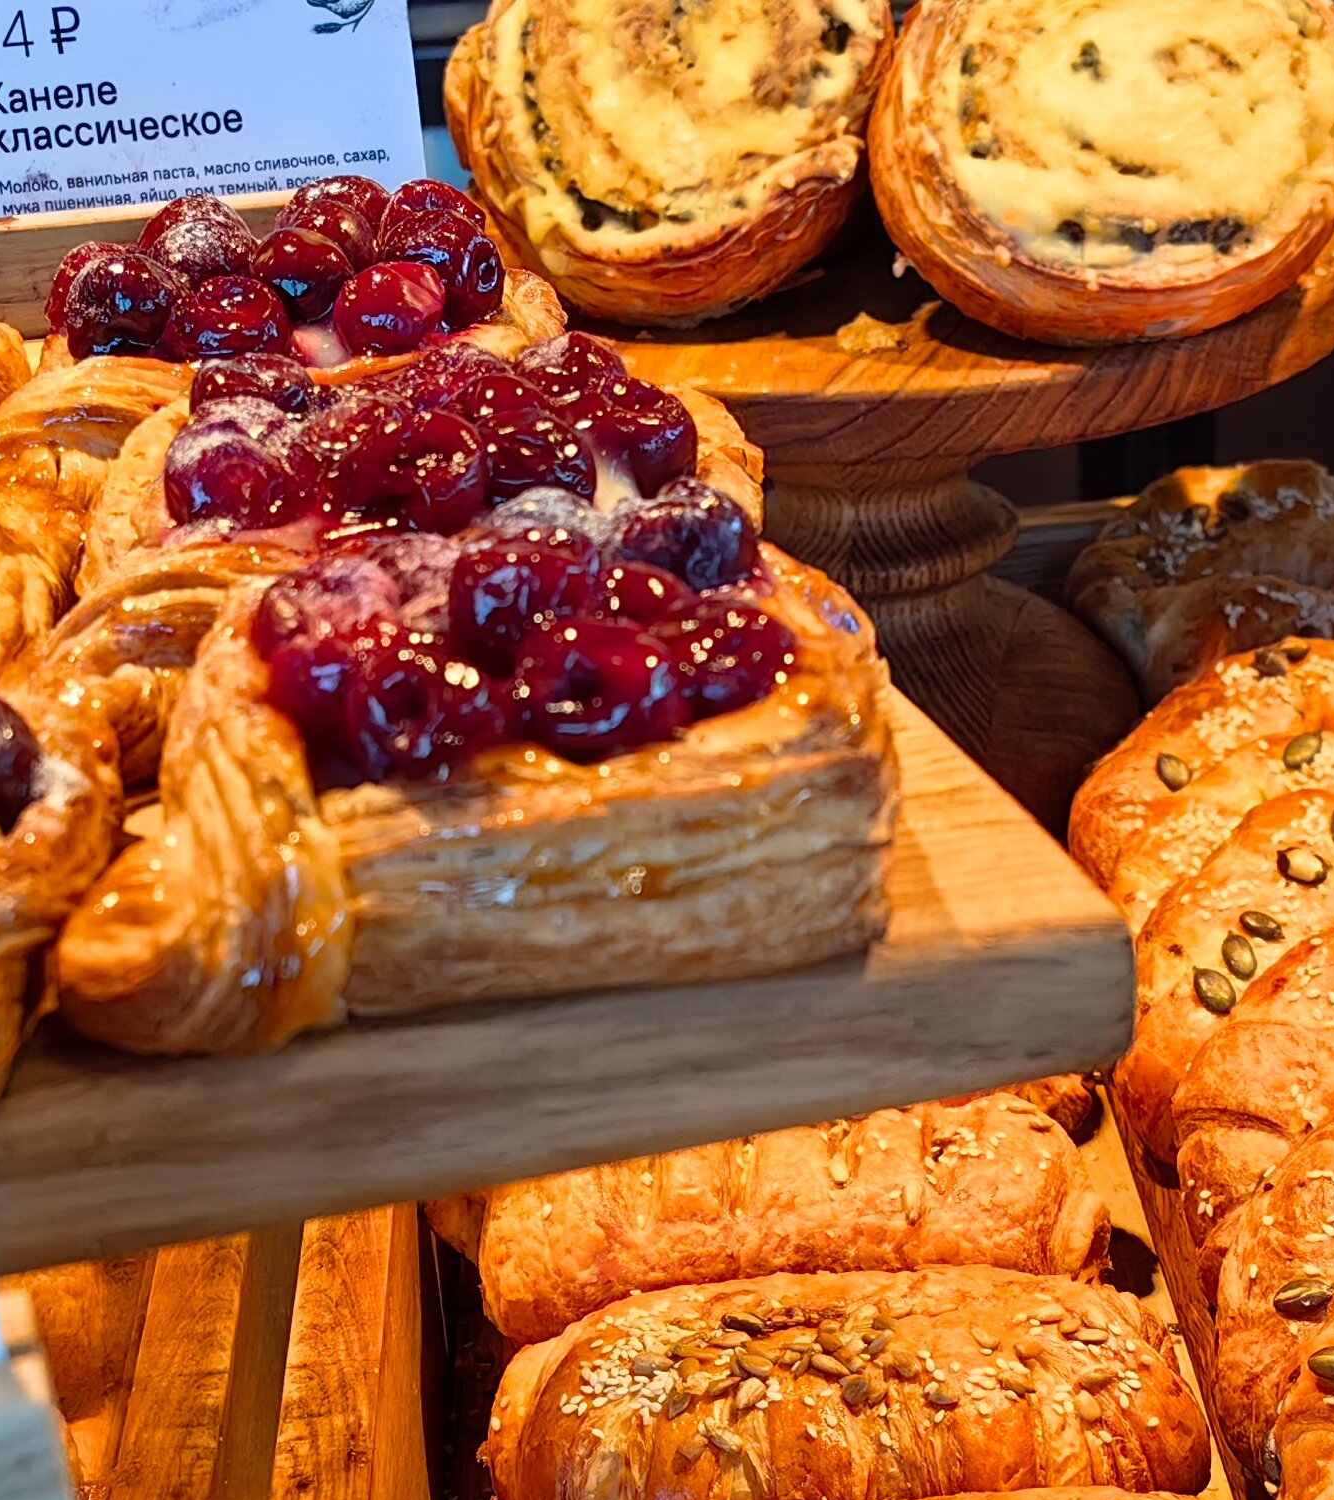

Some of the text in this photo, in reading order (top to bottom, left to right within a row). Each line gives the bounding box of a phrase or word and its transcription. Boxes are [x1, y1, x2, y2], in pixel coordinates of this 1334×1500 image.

[50, 6, 80, 54] ₽
[0, 149, 391, 195] Молоко, ванильная паста, масло сливочное, сахар,
